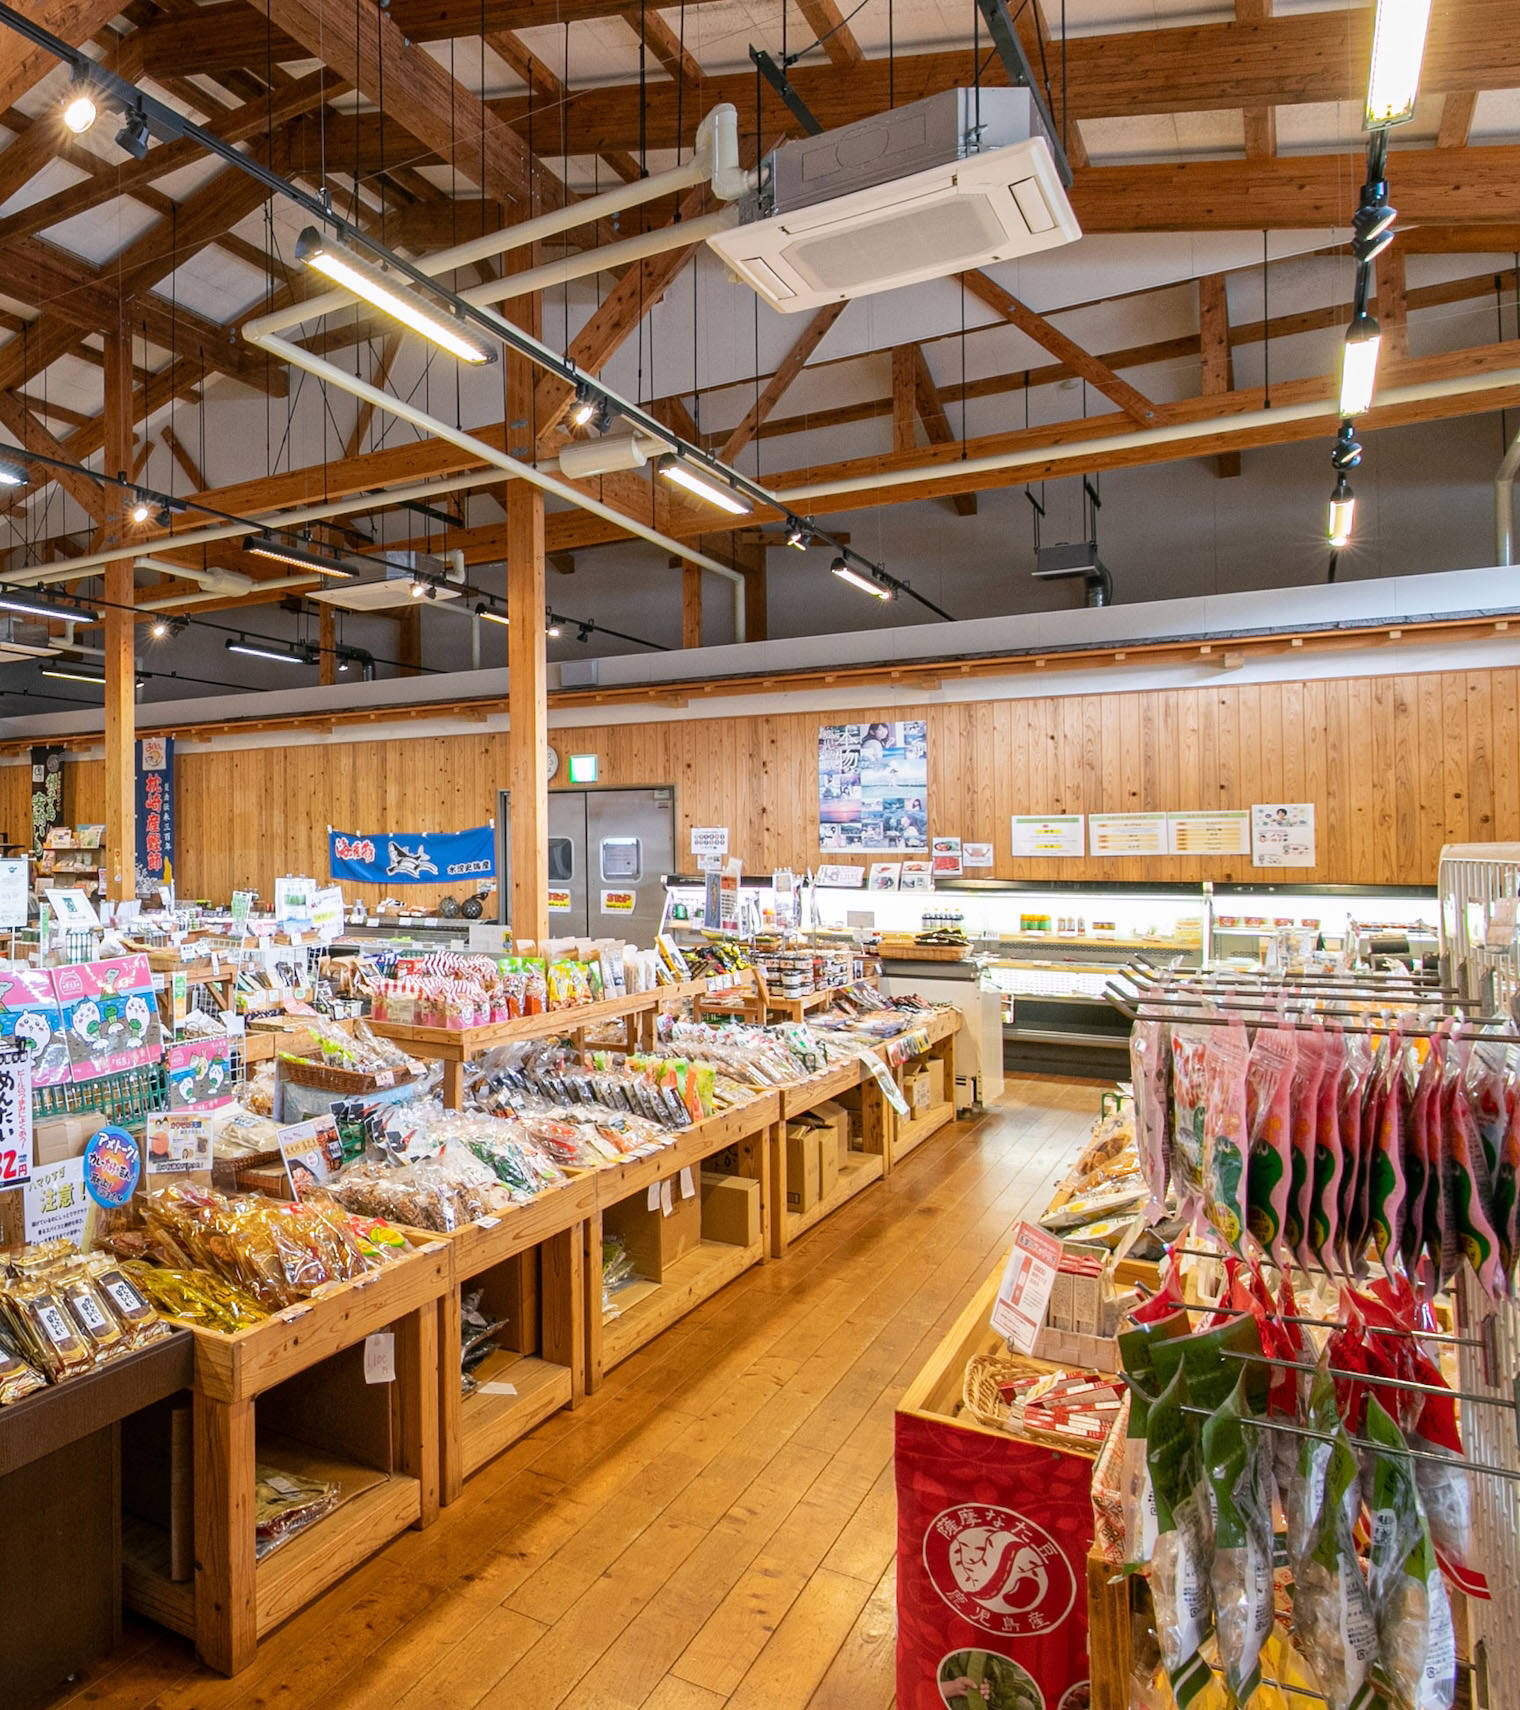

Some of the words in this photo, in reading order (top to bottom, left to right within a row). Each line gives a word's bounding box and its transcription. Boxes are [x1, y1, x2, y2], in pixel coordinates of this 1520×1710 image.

[935, 1507, 1058, 1567] 薩摩なた豆
[945, 1588, 1051, 1634] 鹿児島産
